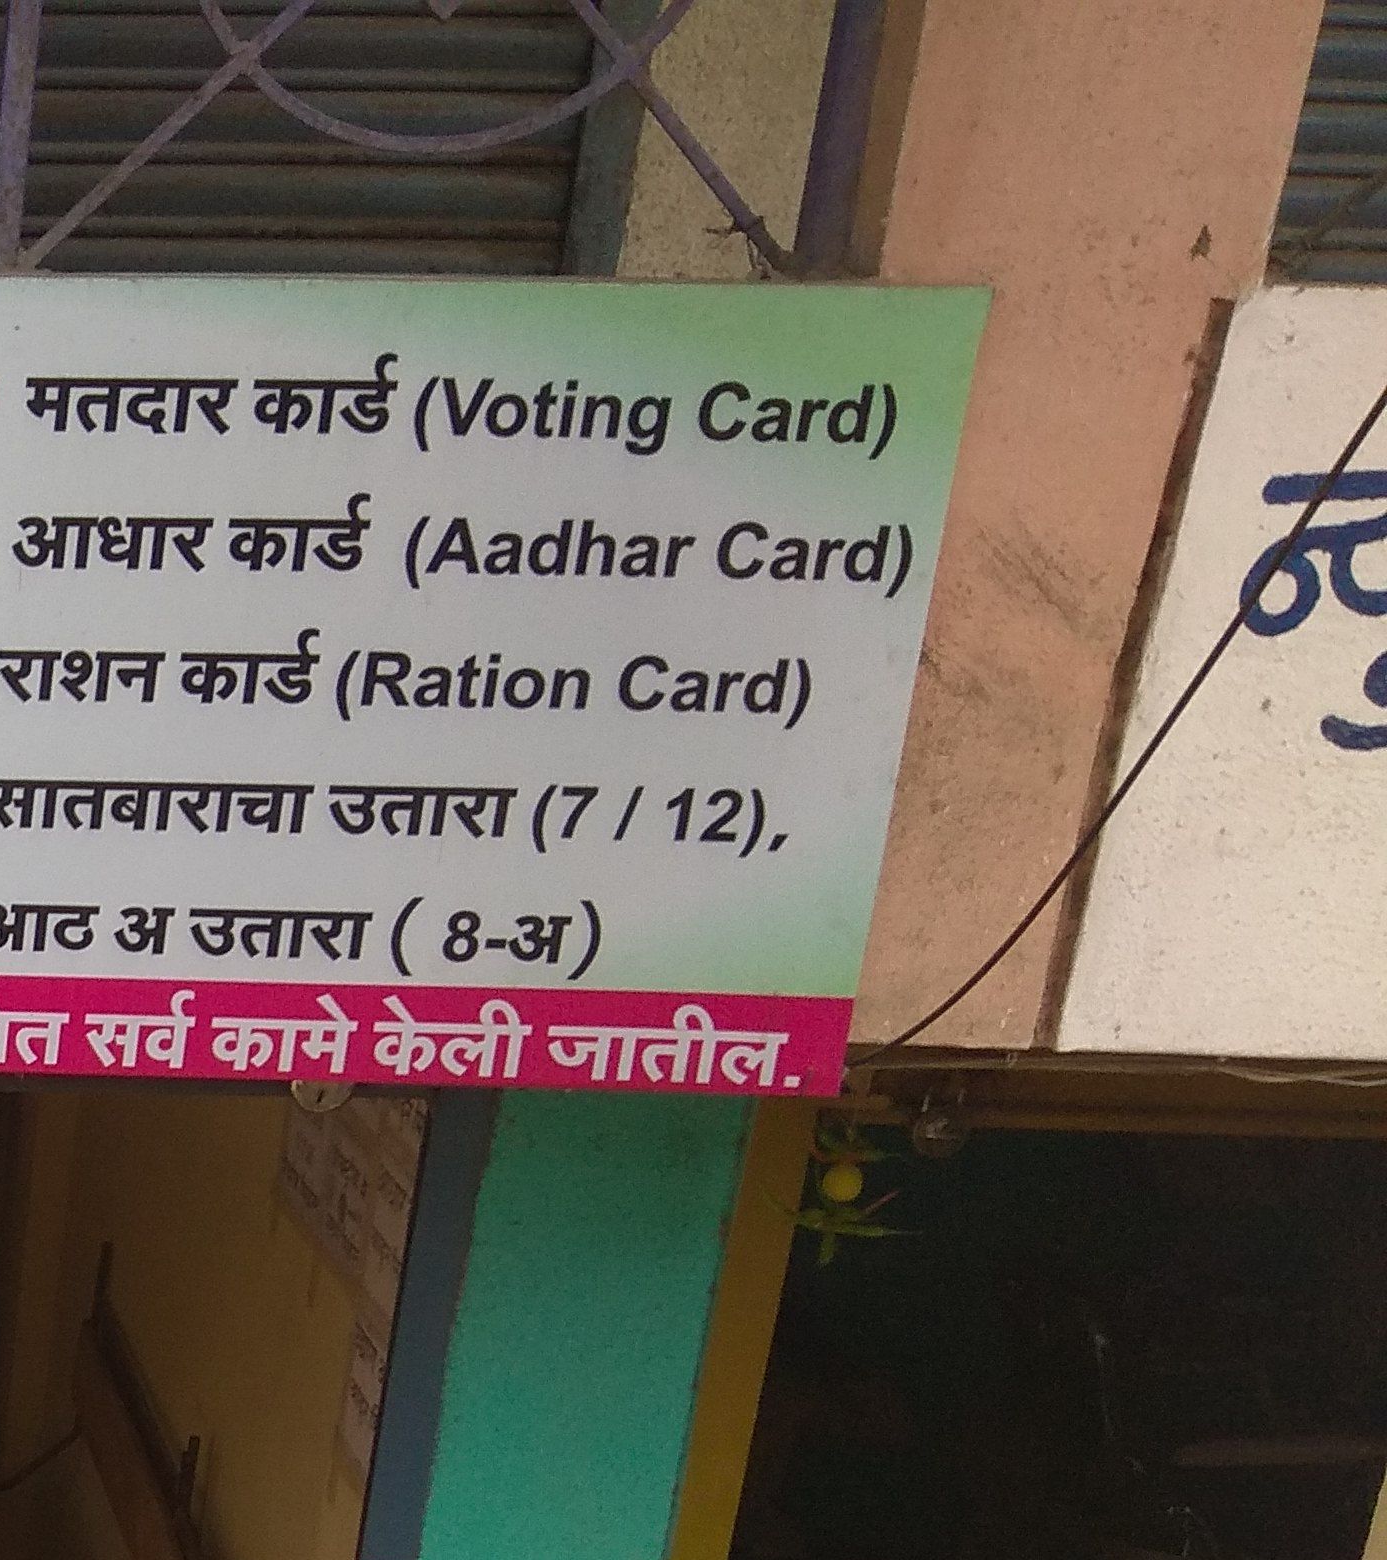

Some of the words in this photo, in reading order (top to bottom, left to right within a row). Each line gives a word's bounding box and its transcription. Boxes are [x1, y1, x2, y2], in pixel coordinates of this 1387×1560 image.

[26, 378, 239, 434] मतदार
[254, 353, 398, 434] कार्ड
[414, 377, 671, 455] (Voting
[698, 382, 896, 460] Card)
[12, 517, 214, 572] आधार
[229, 493, 371, 571] कार्ड
[406, 516, 696, 589] (Aadhar
[717, 522, 912, 598] Card)
[0, 650, 166, 702] राशन
[181, 629, 320, 704] कार्ड
[336, 651, 590, 721] (Ration
[619, 656, 810, 729] Card)
[329, 785, 518, 838] उतारा
[114, 908, 175, 954] अ
[190, 909, 373, 960] उतारा
[85, 990, 195, 1068] सर्व
[212, 994, 358, 1073] कामे
[374, 995, 532, 1077] केली
[548, 1005, 800, 1087] जातील.
